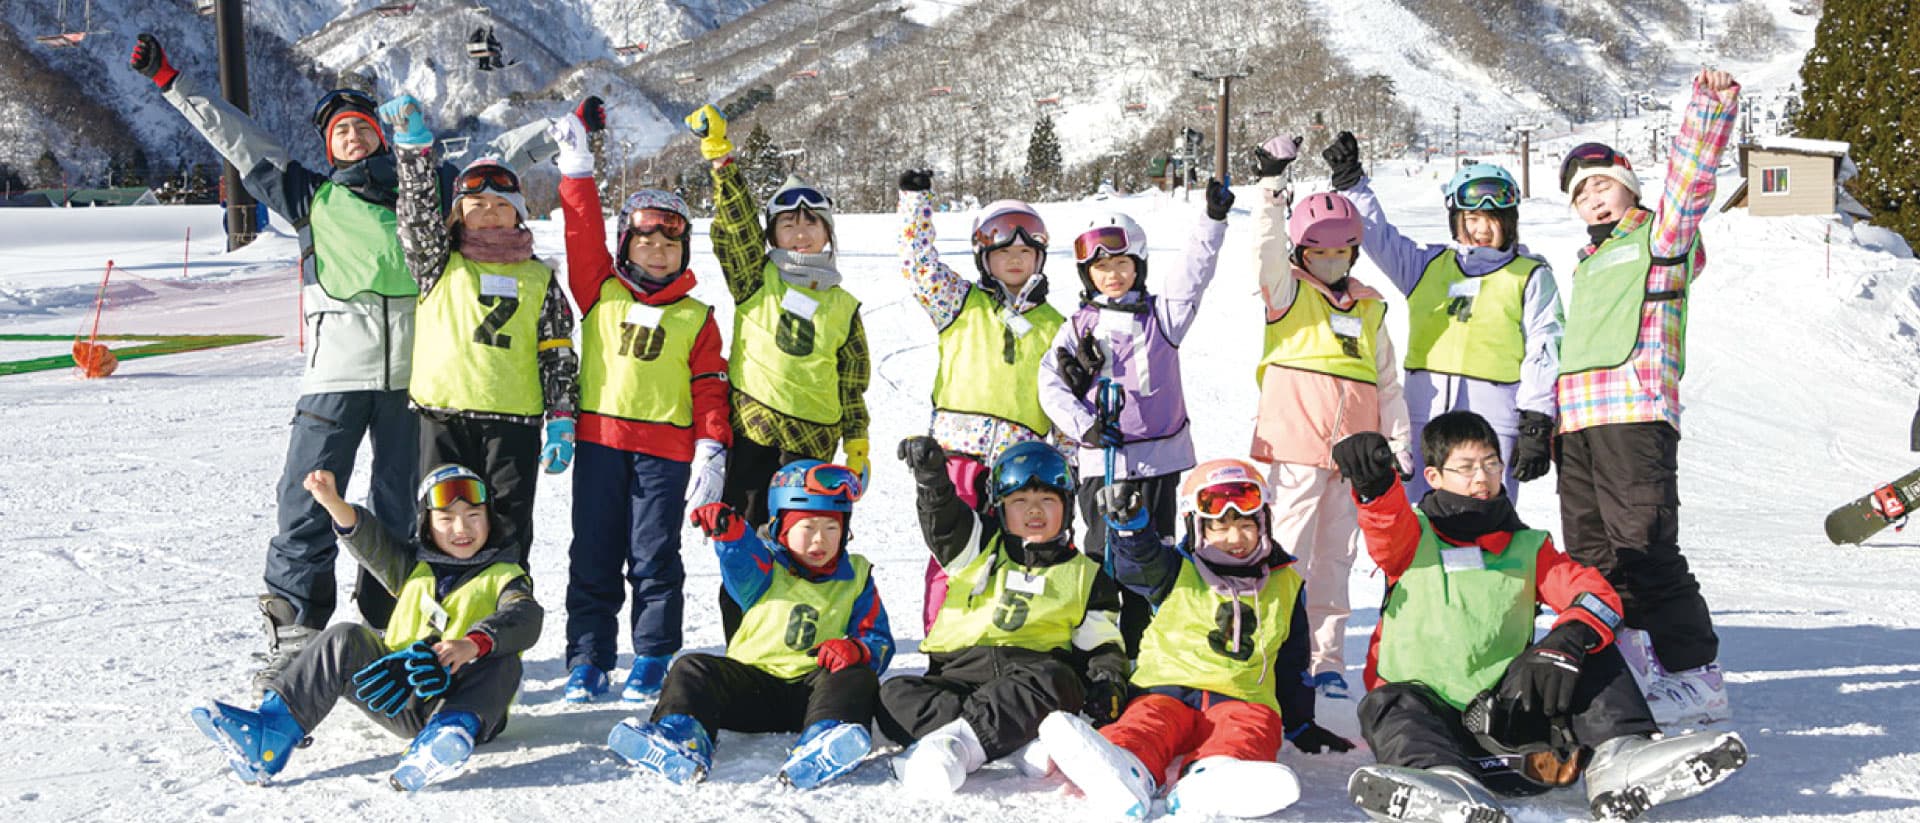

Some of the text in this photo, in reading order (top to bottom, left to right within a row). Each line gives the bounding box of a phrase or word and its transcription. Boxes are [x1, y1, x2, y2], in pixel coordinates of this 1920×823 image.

[472, 294, 520, 349] 2
[618, 321, 666, 362] 10
[784, 603, 819, 651] 6
[992, 589, 1034, 632] 5
